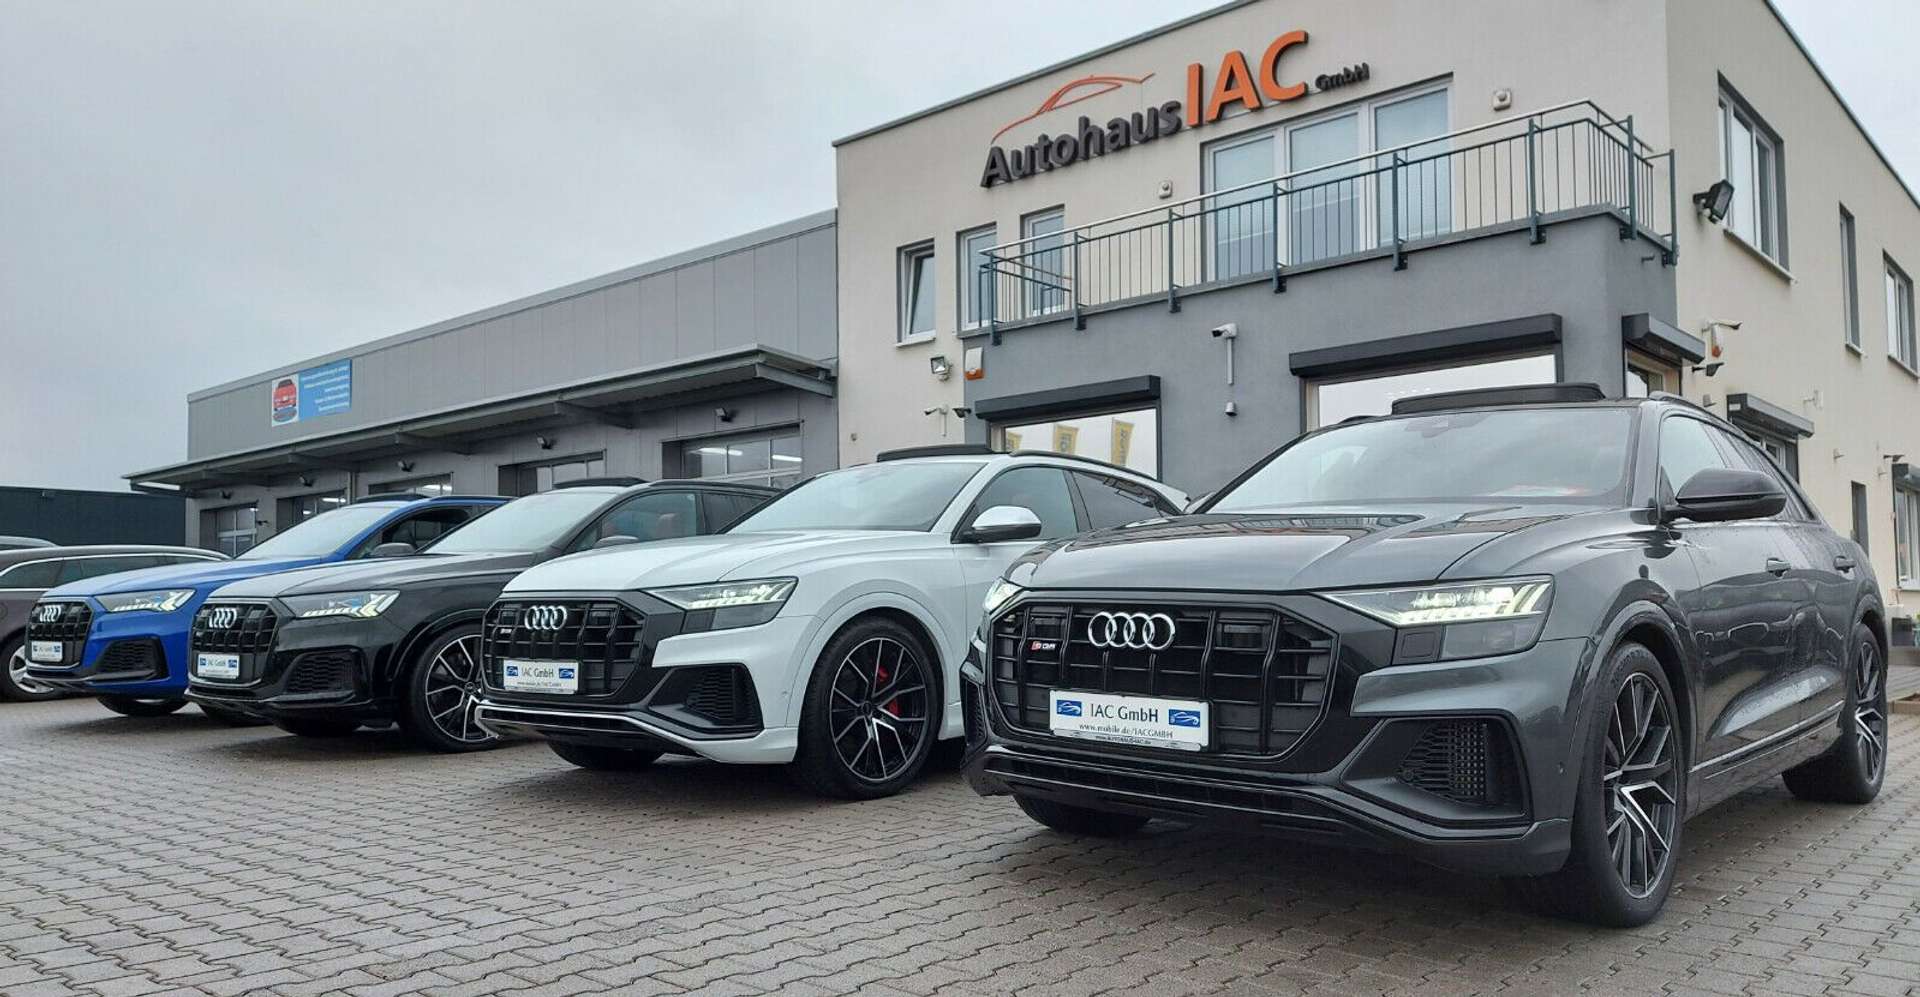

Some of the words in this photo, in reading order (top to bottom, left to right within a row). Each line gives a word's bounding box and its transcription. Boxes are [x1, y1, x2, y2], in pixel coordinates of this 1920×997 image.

[980, 100, 1182, 188] Autohaus
[1186, 30, 1309, 128] IAC
[1315, 62, 1370, 91] GmbH
[1090, 703, 1114, 719] IAC
[1118, 705, 1159, 723] GmbH
